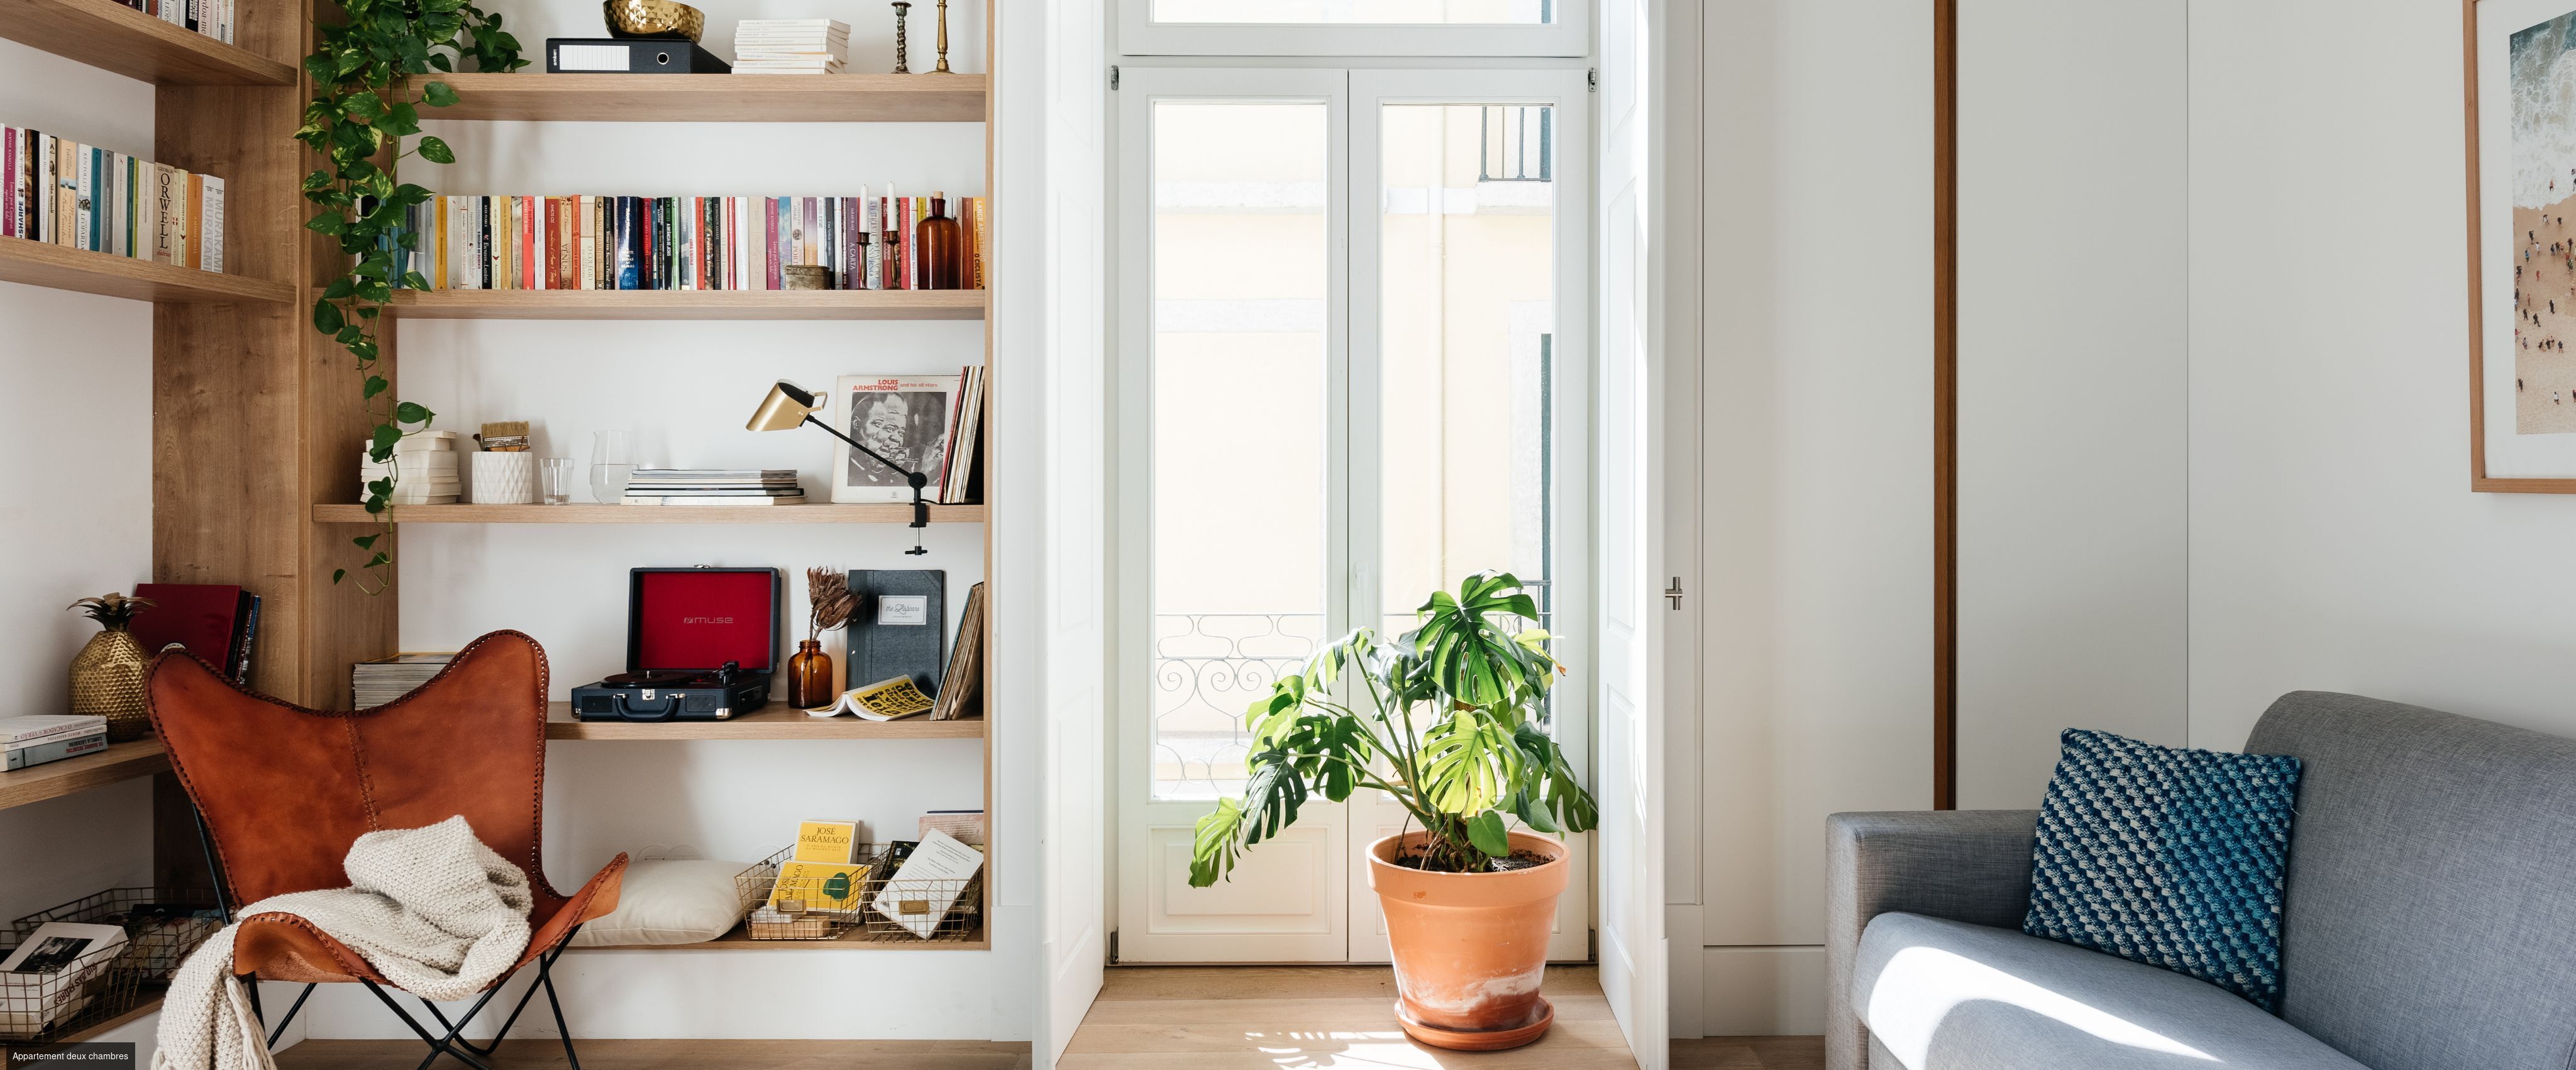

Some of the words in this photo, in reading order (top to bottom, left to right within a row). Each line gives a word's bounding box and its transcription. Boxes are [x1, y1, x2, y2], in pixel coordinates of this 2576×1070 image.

[159, 173, 171, 248] ORWELL
[204, 196, 213, 269] MURAKAMI
[214, 199, 223, 272] MURAKAMI
[978, 223, 986, 262] ARMSTRONG
[20, 731, 38, 739] VERÃO
[44, 725, 67, 735] CAÇADOR
[66, 745, 84, 754] SECRETOS
[815, 827, 836, 836] JOSÉ
[800, 835, 849, 844] SARAMAGO
